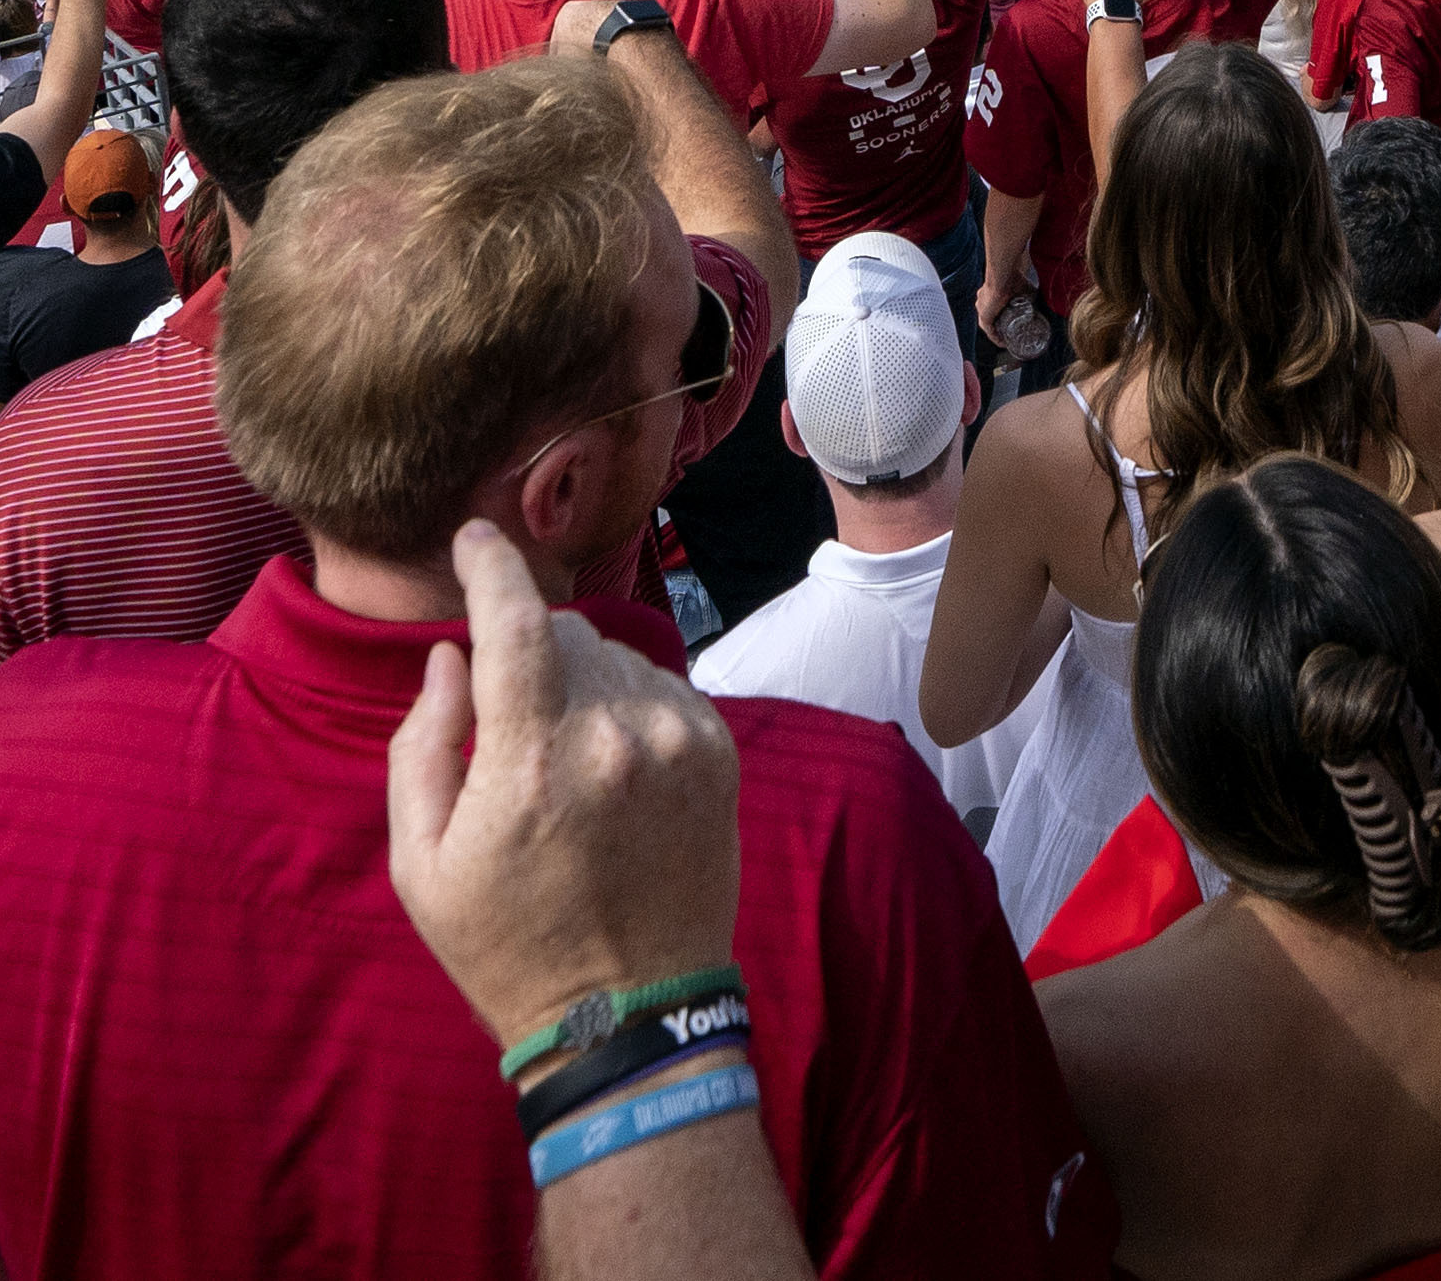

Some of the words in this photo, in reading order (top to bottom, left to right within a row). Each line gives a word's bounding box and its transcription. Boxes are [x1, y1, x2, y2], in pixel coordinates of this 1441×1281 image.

[1365, 54, 1388, 105] 1
[849, 81, 946, 130] OKLAHOMA
[856, 101, 953, 155] SOONERS
